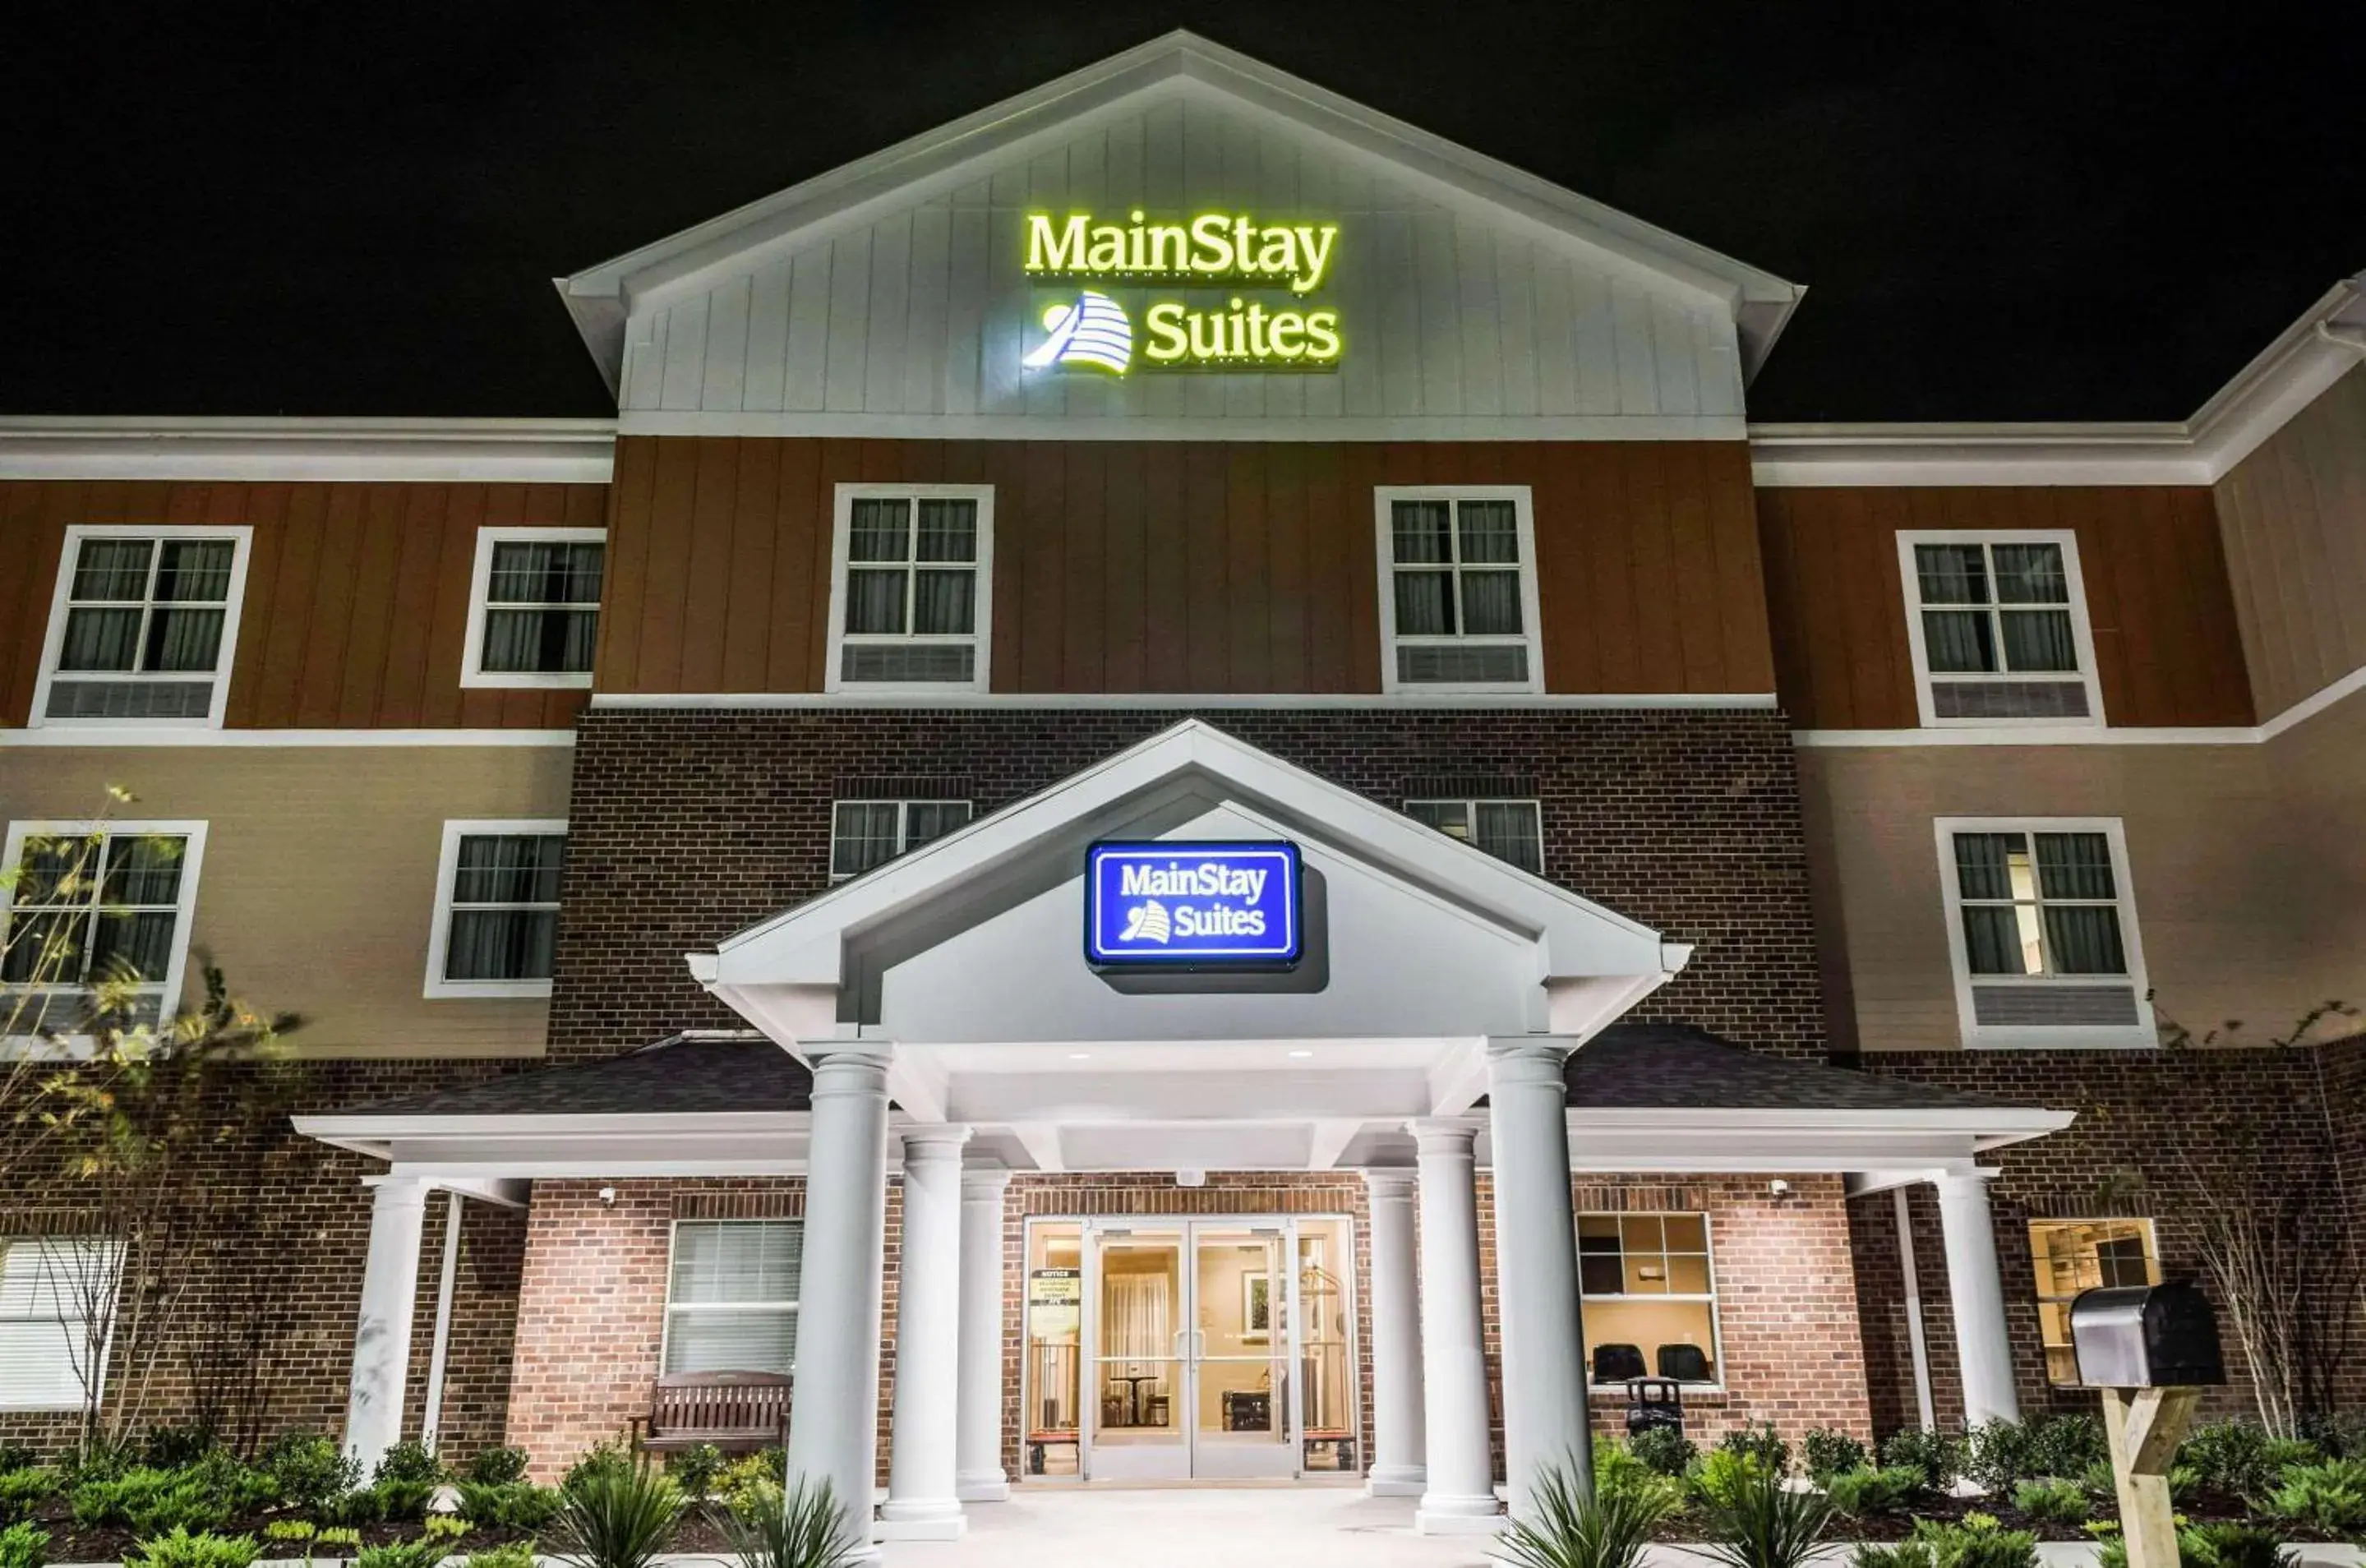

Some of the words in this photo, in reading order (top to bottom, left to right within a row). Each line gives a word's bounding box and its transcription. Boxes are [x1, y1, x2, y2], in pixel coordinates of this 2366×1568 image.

[1024, 210, 1338, 292] MainStay
[1146, 297, 1340, 359] Suites
[1120, 862, 1268, 906] MainStay
[1174, 902, 1266, 937] Suites
